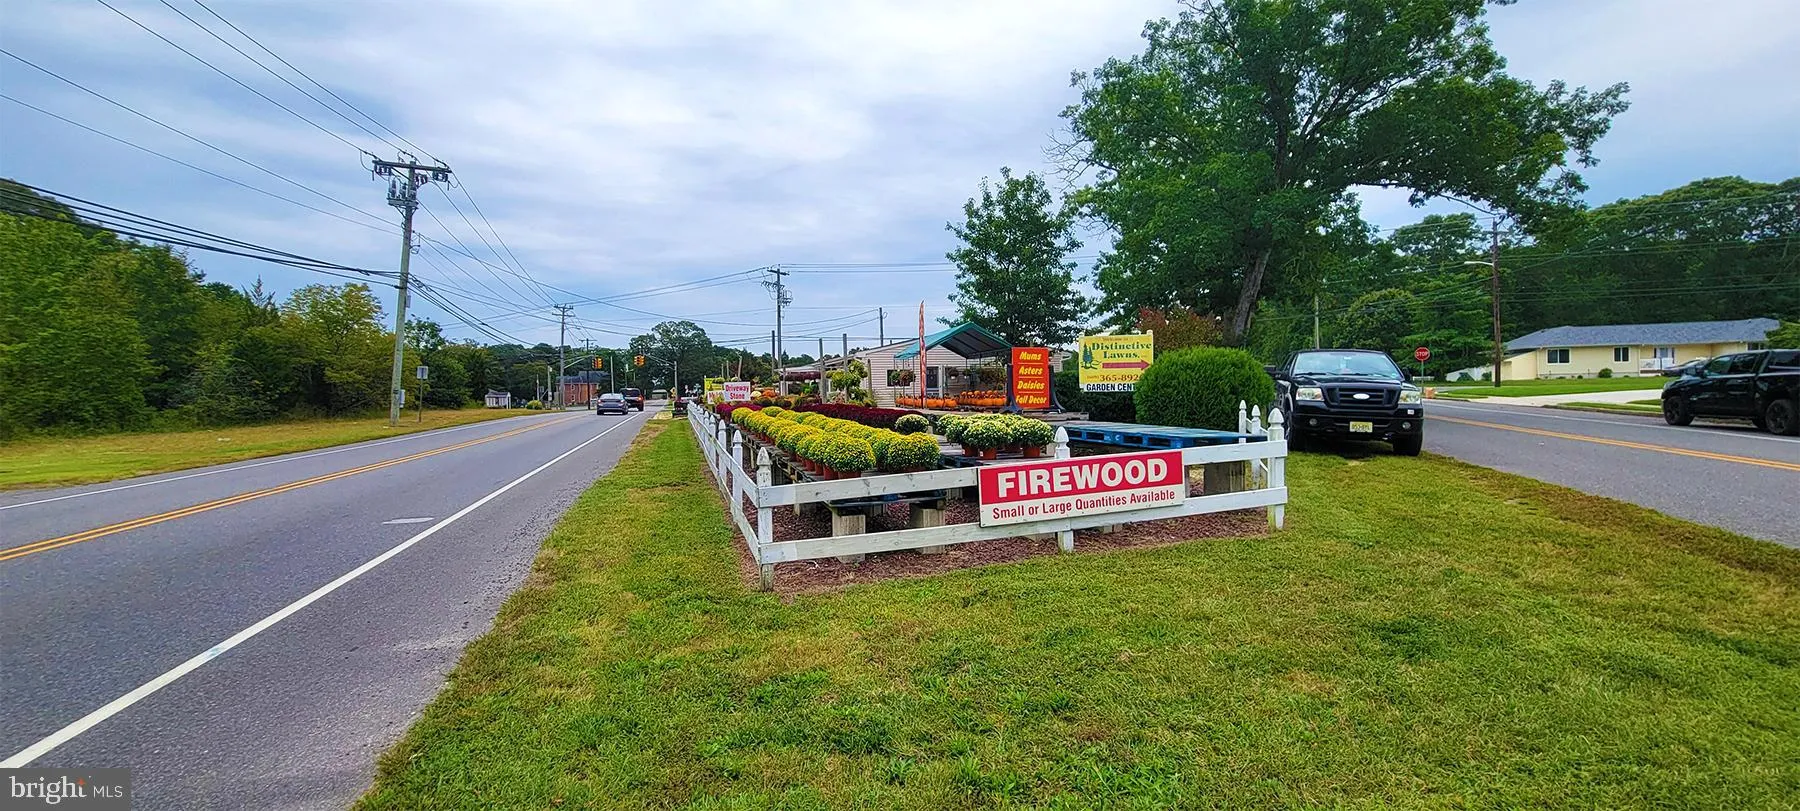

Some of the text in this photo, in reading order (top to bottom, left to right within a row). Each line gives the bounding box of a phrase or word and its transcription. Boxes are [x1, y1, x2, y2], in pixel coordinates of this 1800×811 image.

[1091, 342, 1152, 351] Distinctive
[1019, 351, 1042, 361] Mums
[1019, 366, 1043, 375] Asters
[725, 384, 749, 392] Driveway
[1017, 380, 1045, 390] Daisies
[1086, 383, 1116, 391] GARDEN
[730, 392, 745, 400] Stone
[1016, 395, 1047, 404] Fall Decor
[997, 458, 1167, 498] FIREWOOD
[992, 489, 1175, 520] Small or Large Quantities Available
